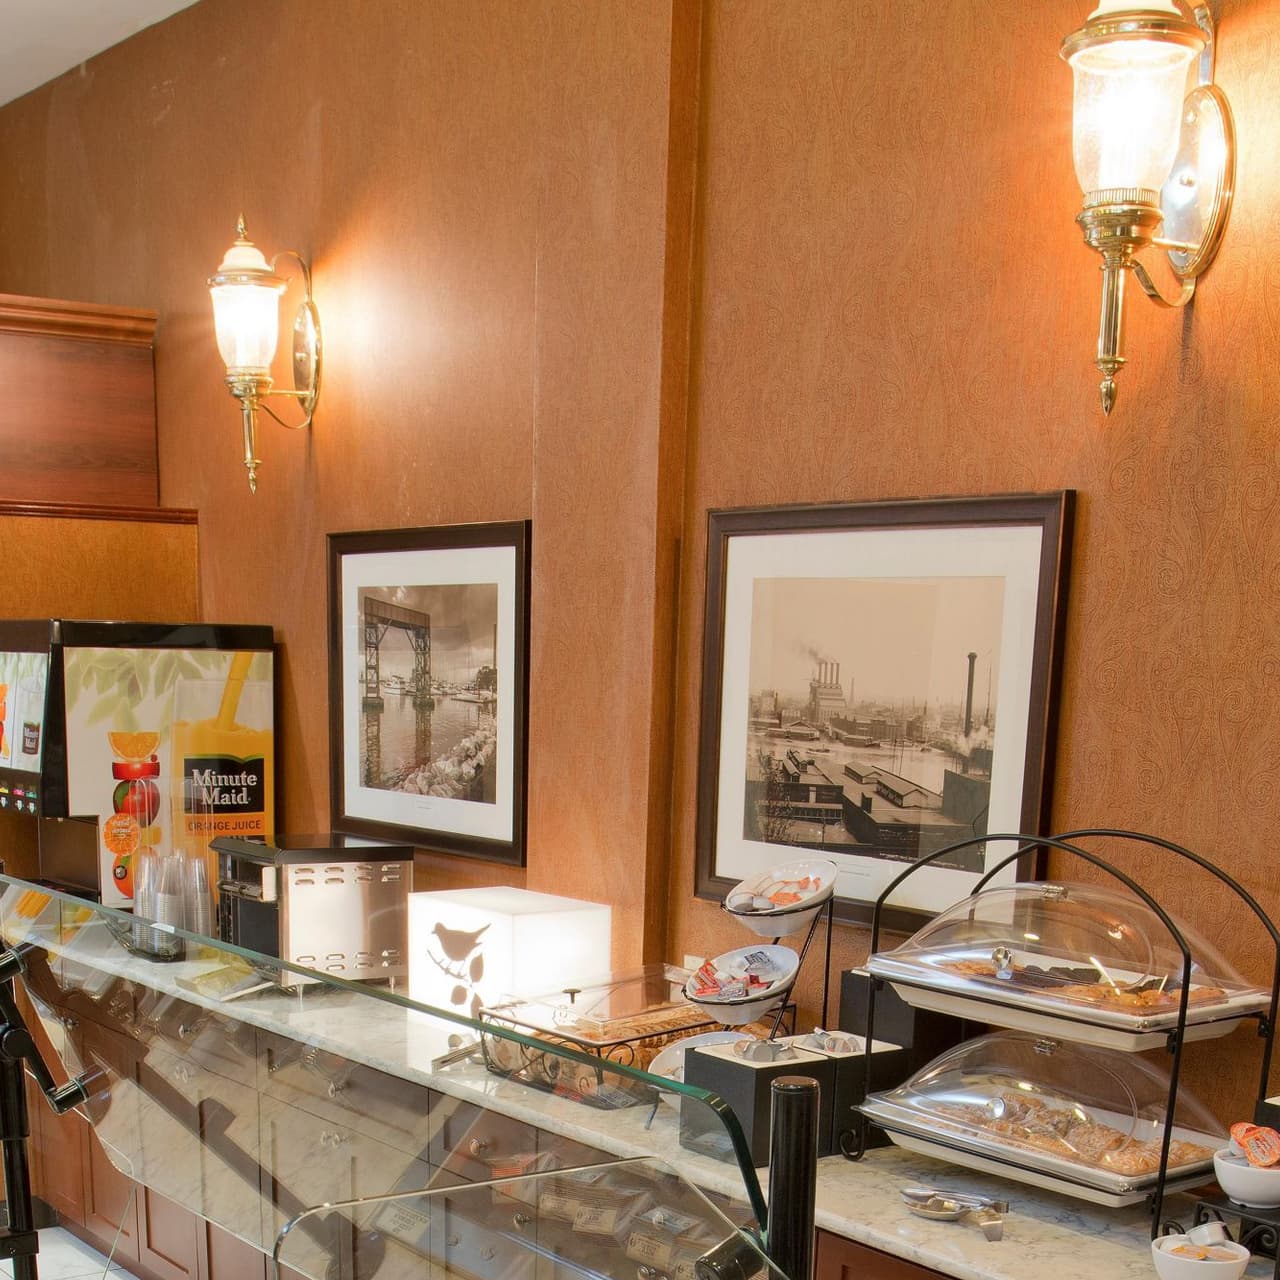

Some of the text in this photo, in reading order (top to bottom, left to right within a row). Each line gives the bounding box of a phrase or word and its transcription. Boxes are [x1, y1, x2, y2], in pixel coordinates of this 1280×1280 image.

[192, 769, 258, 786] Minute
[201, 787, 249, 805] Maid
[188, 820, 261, 832] ORANGE JUICE
